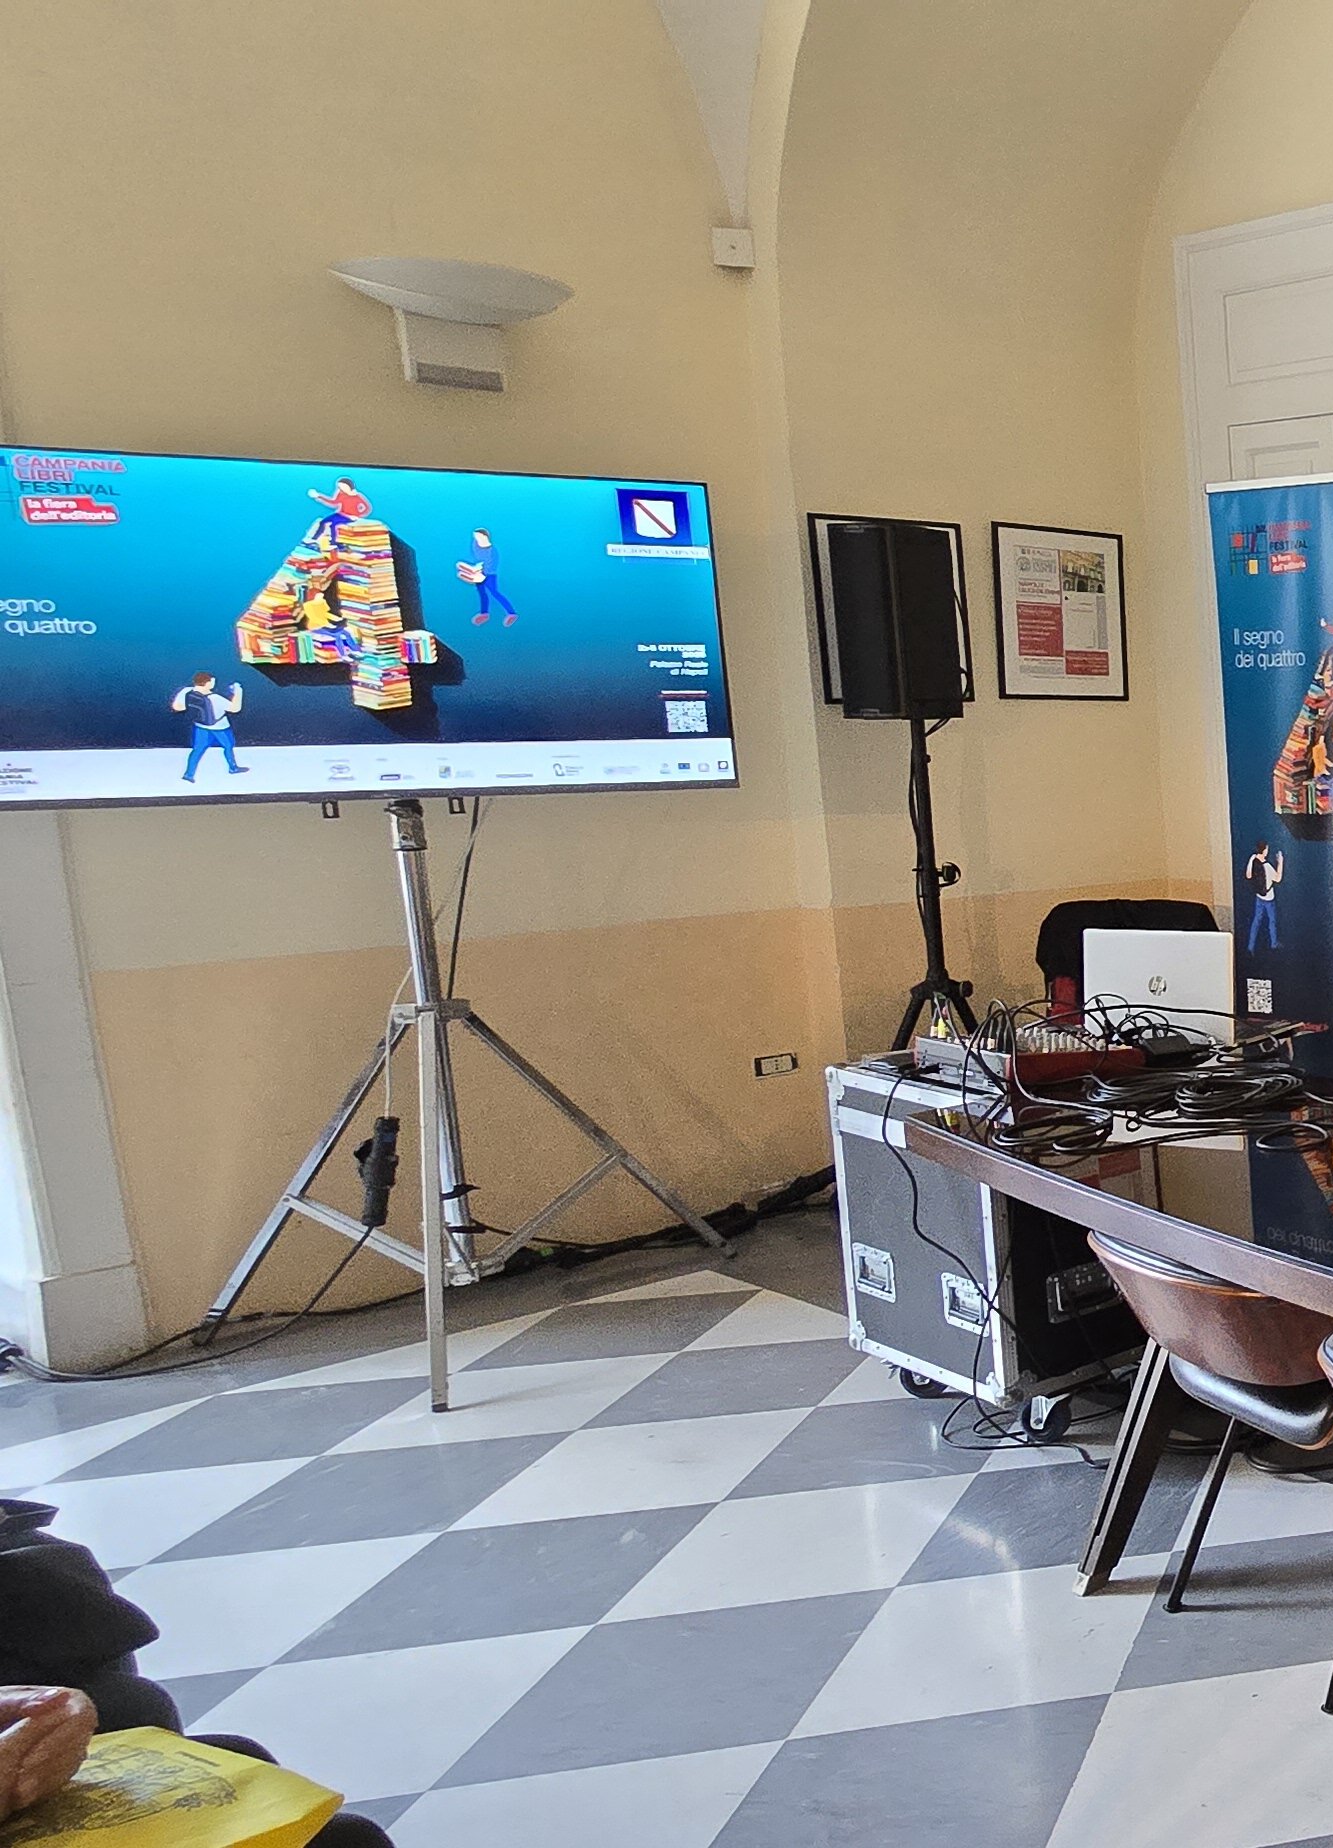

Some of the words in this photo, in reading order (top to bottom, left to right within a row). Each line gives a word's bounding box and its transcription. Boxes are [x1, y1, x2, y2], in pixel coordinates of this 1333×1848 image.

[14, 455, 126, 472] CAMPANIA
[16, 467, 73, 481] LIBRI
[20, 481, 120, 496] FESTIVAL
[4, 617, 97, 637] quattro
[1233, 628, 1240, 645] Il
[1243, 630, 1284, 649] segno
[1235, 649, 1254, 668] dei
[1257, 649, 1306, 671] quattro
